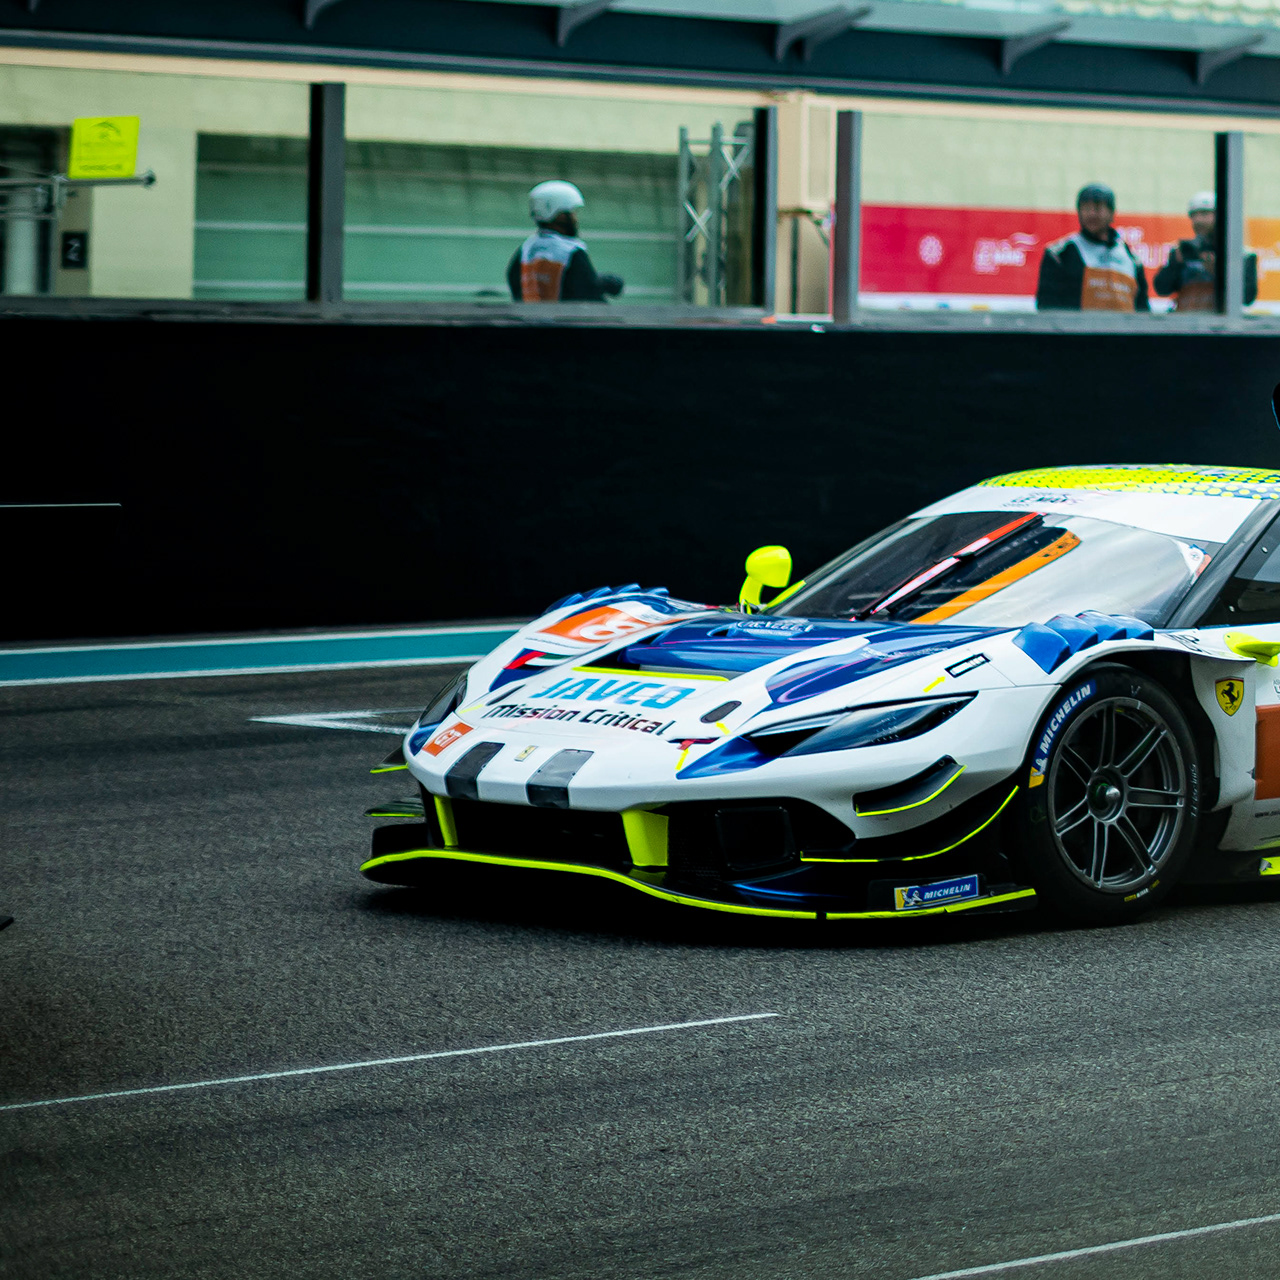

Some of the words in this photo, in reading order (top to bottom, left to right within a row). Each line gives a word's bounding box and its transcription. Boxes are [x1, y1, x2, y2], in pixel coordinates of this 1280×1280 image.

[527, 677, 697, 710] JAVCO
[481, 703, 580, 722] Mission
[577, 709, 677, 737] Critical
[1039, 683, 1093, 755] MICHELIN
[924, 883, 972, 899] MICHELIN
